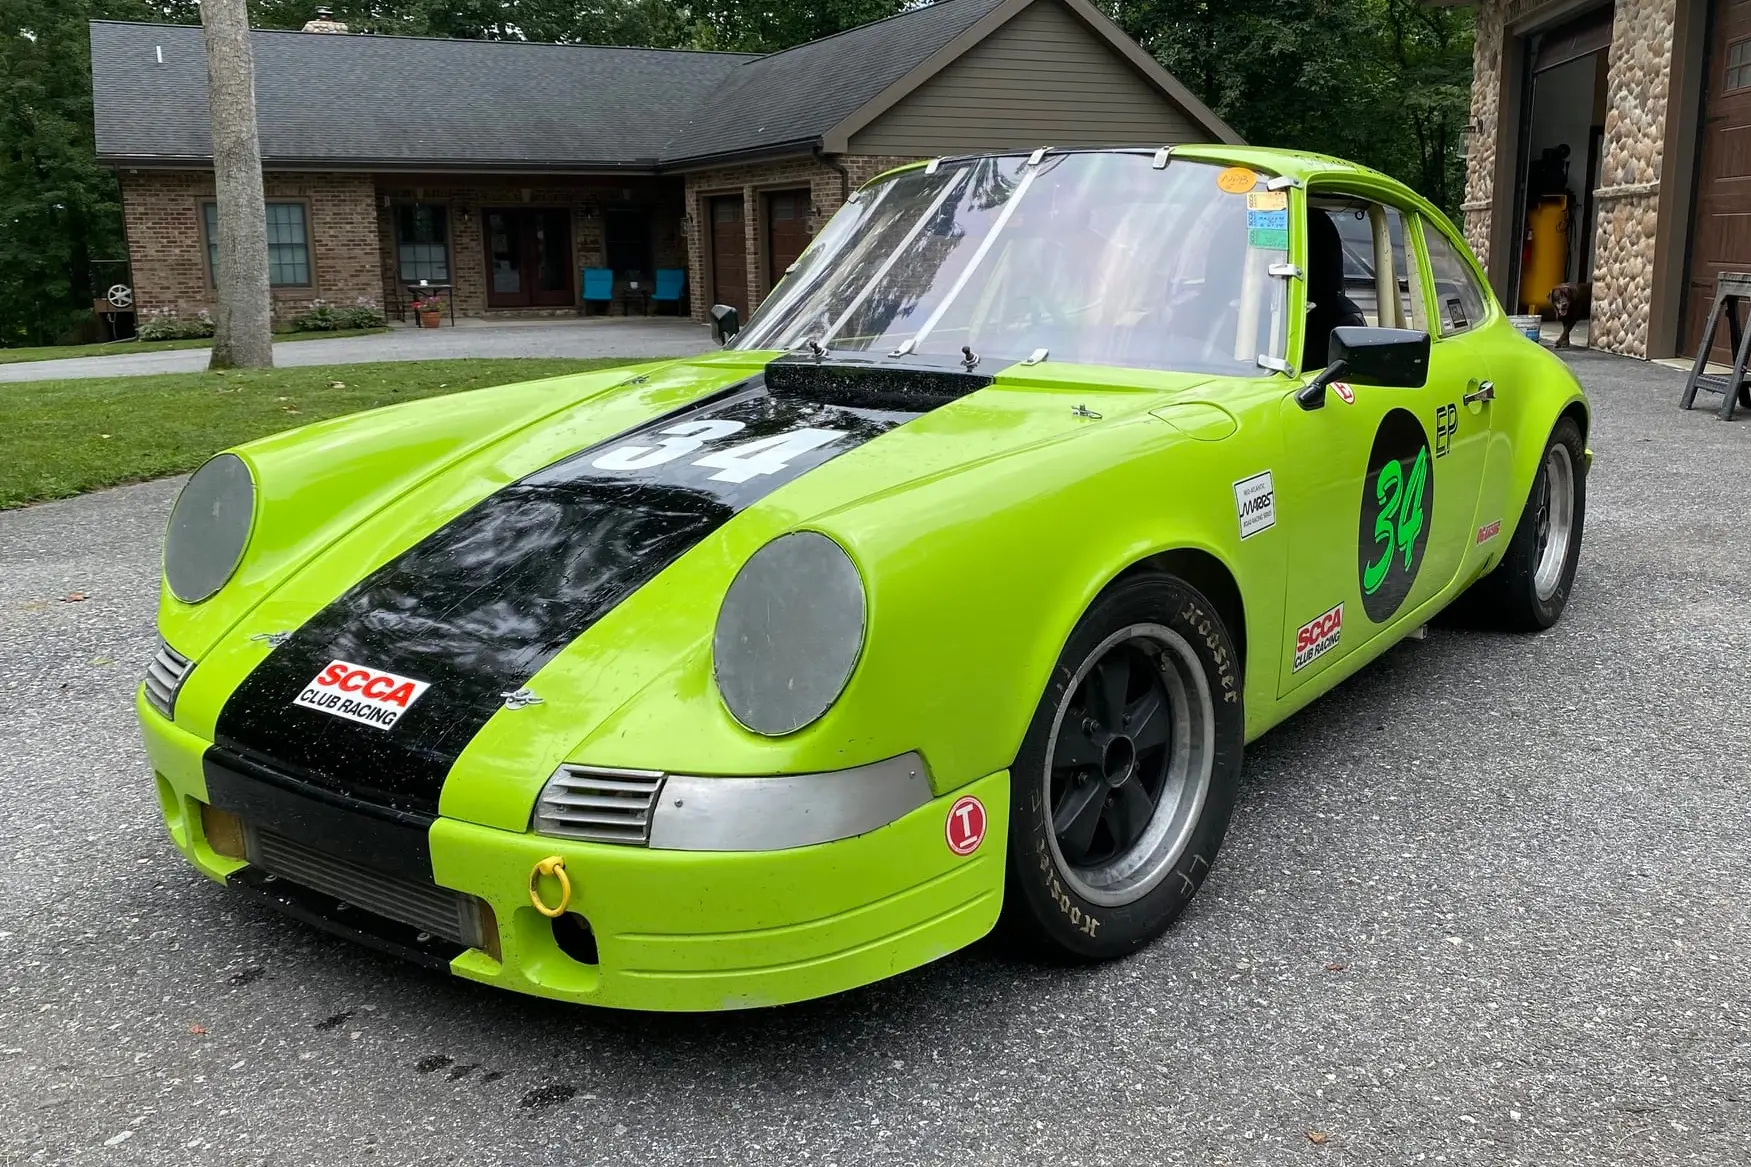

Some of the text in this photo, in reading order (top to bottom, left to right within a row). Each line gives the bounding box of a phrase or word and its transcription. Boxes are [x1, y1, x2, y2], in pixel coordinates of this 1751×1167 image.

[592, 419, 848, 484] 34
[1435, 403, 1459, 459] EP
[1363, 445, 1428, 596] 34
[1181, 602, 1238, 704] Hoosier
[1295, 630, 1340, 669] CLUB RACING
[1297, 608, 1341, 653] SCCA
[300, 688, 397, 727] CLUB RACING
[317, 664, 416, 708] SCCA
